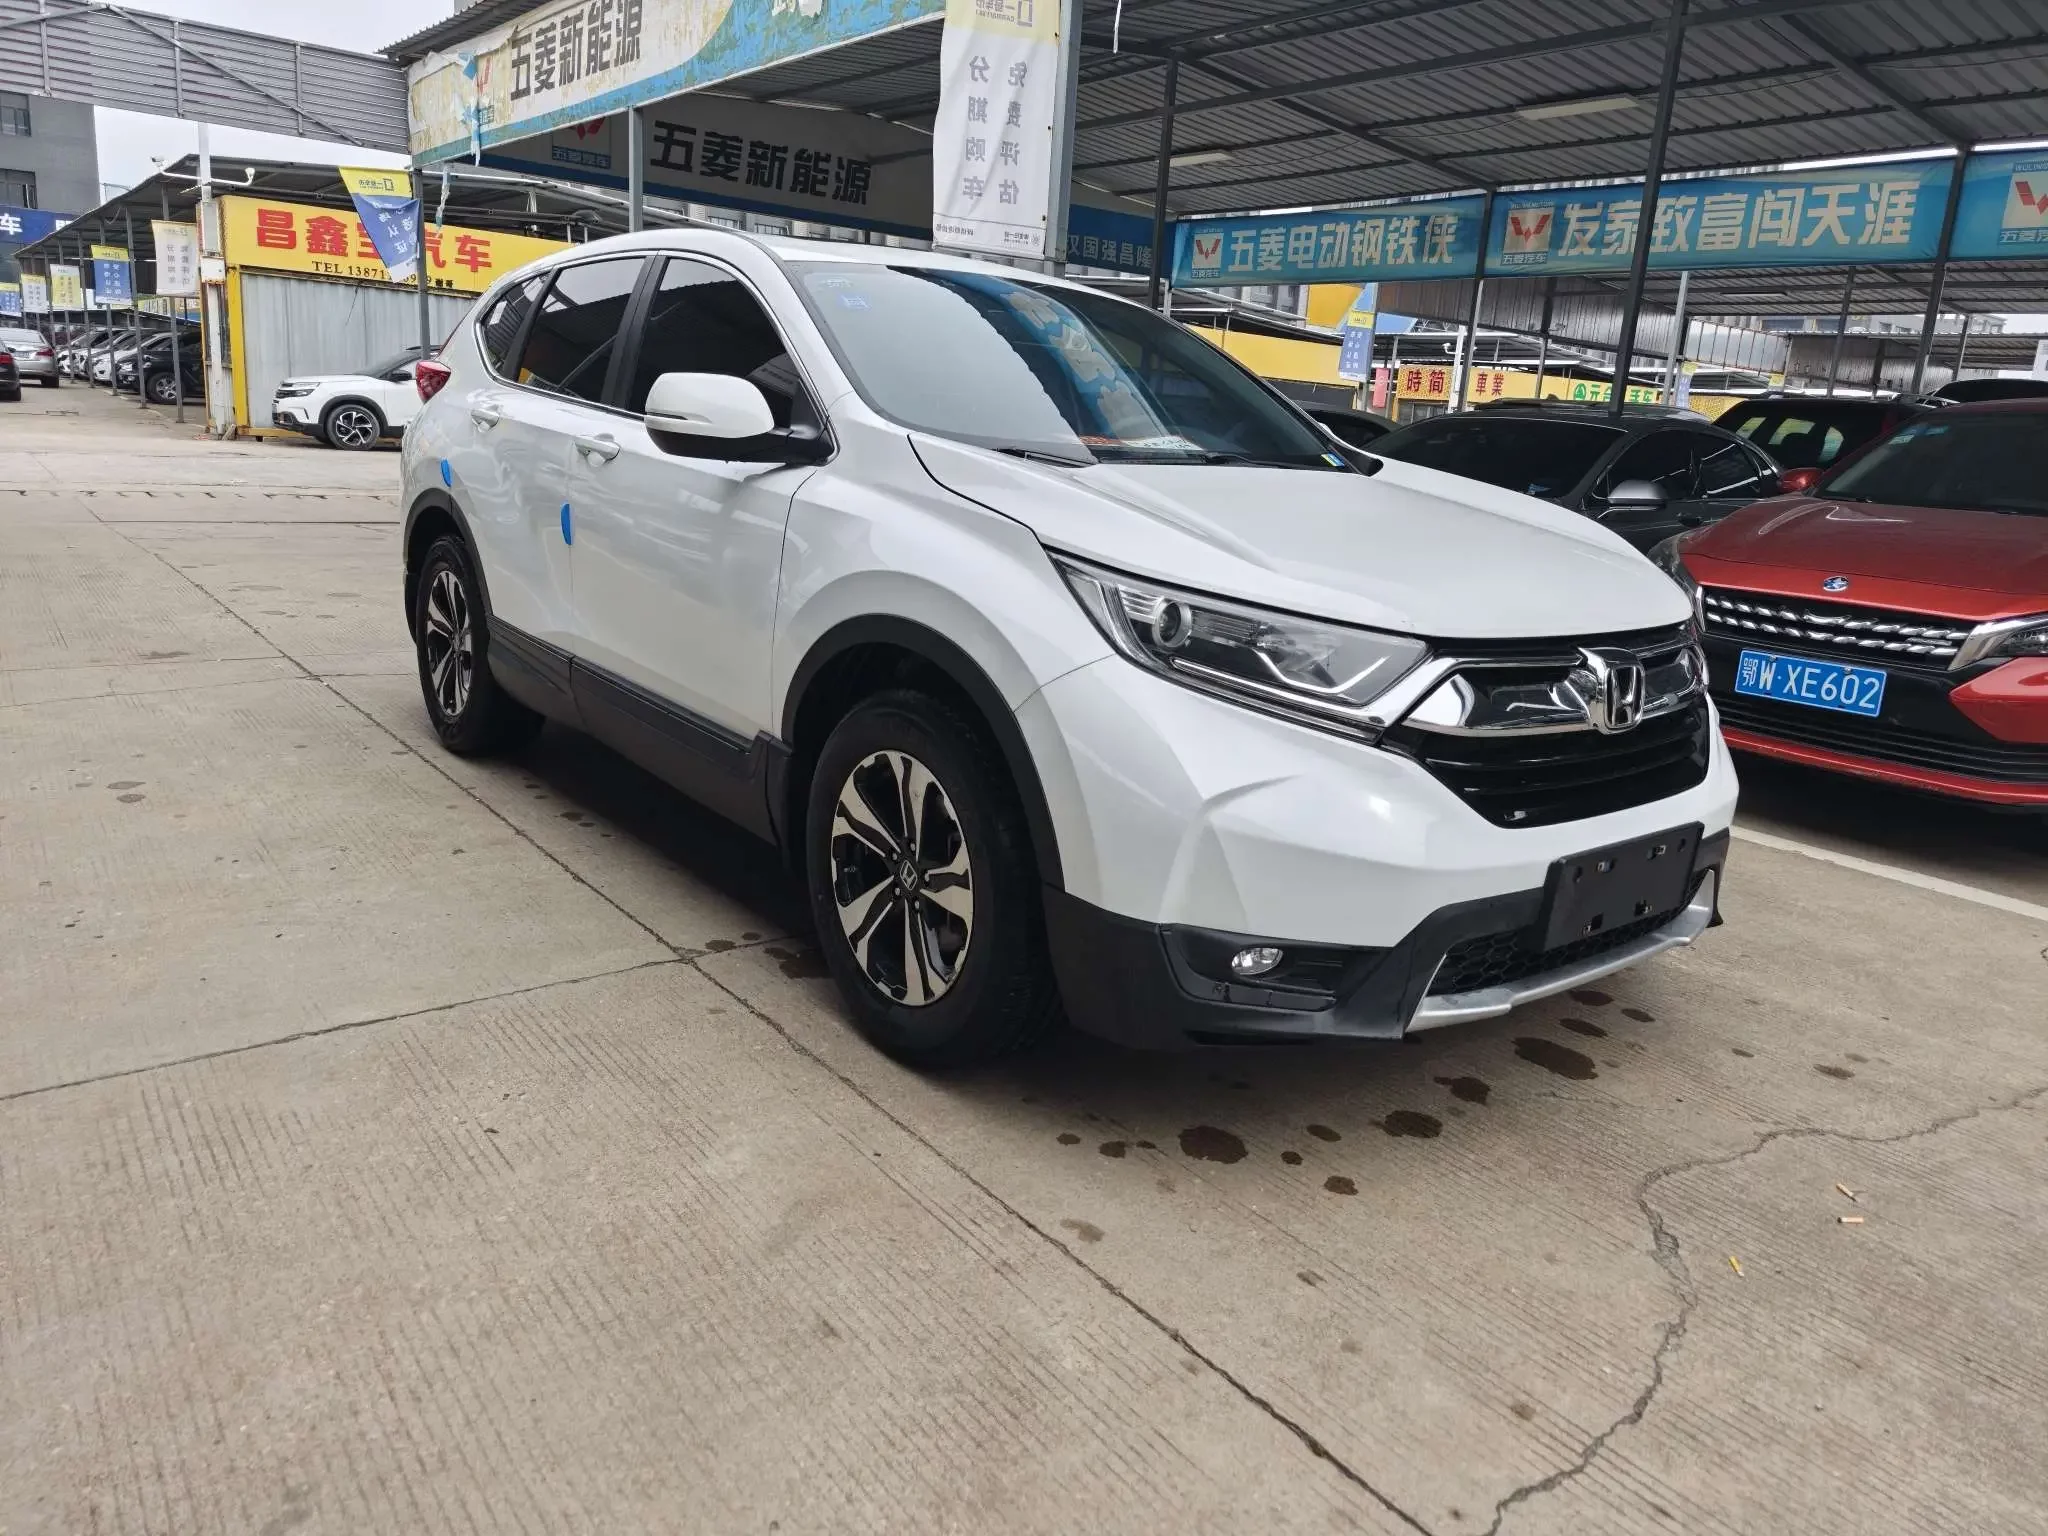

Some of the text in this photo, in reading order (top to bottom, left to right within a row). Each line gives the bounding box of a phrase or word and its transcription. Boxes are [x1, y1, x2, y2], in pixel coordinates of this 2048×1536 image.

[511, 0, 642, 101] 五菱新能源
[650, 120, 872, 205] 五菱新能源
[1228, 214, 1459, 272] 五菱电动钢铁侠
[1558, 180, 1920, 256] 发家致富闯天涯
[312, 261, 343, 275] TEL
